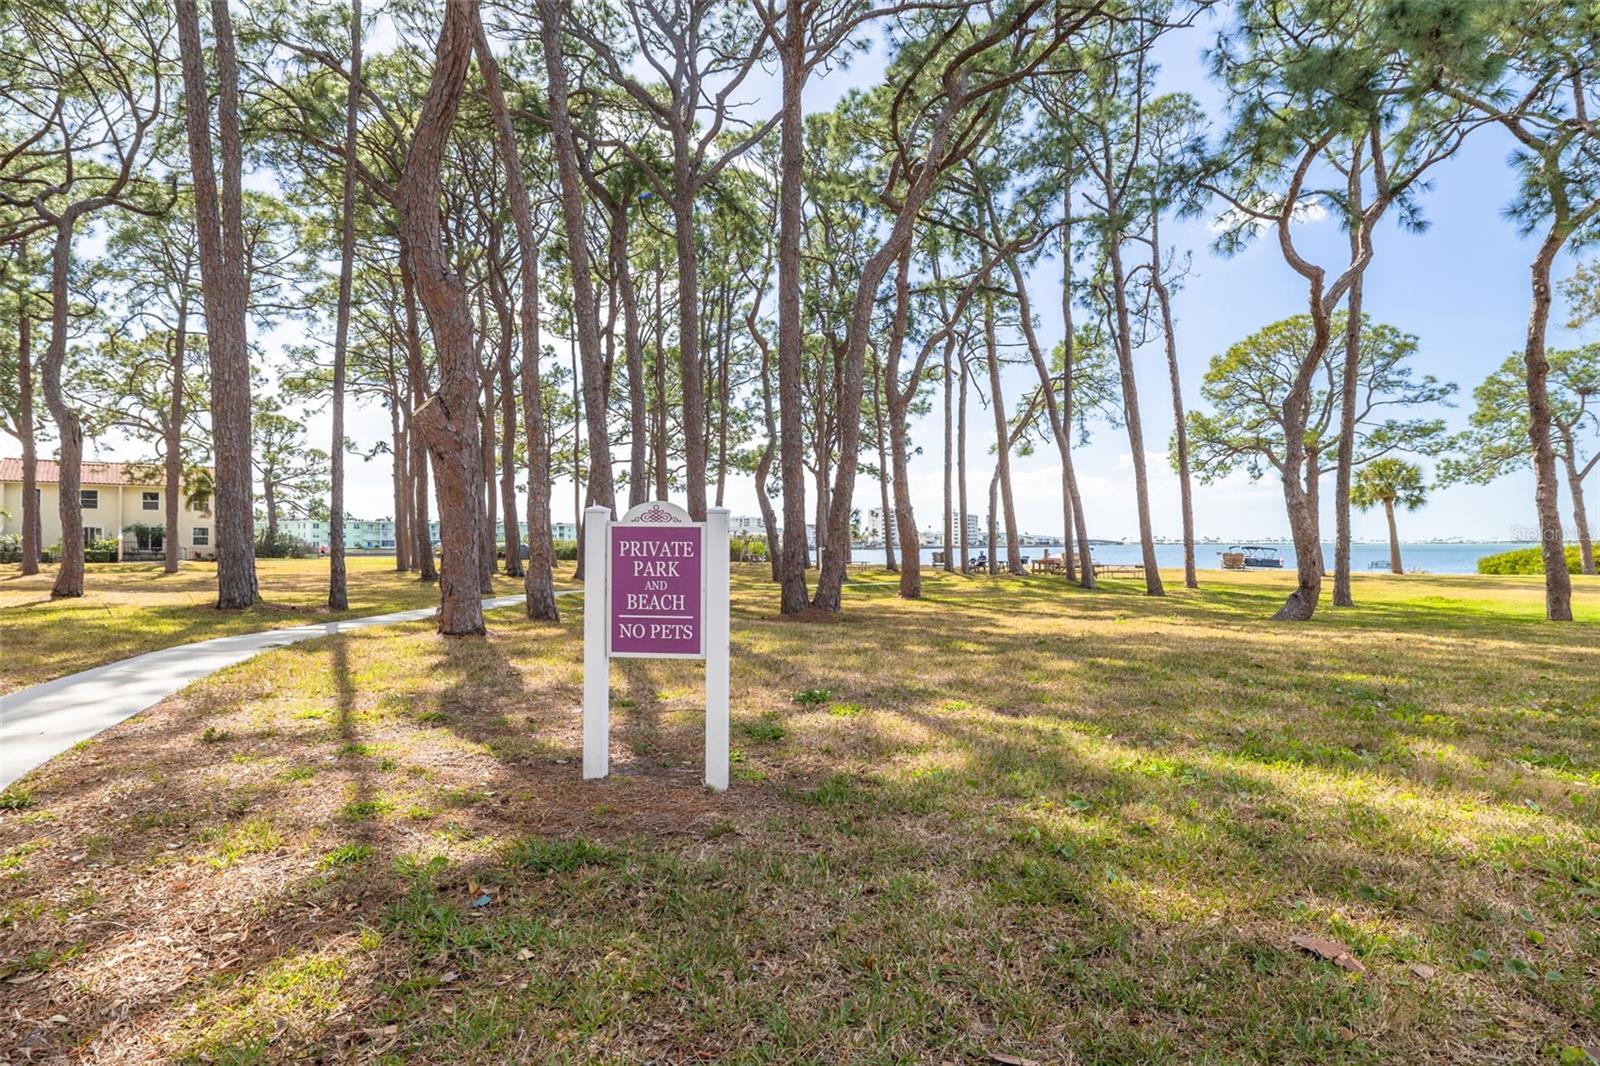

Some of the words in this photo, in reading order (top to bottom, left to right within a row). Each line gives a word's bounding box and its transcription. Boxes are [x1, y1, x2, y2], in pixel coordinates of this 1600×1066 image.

[619, 541, 694, 557] PRIVATE
[633, 560, 680, 577] PARK
[644, 580, 668, 591] AND
[626, 593, 686, 611] BEACH
[619, 623, 646, 639] NO
[650, 624, 693, 640] PETS
